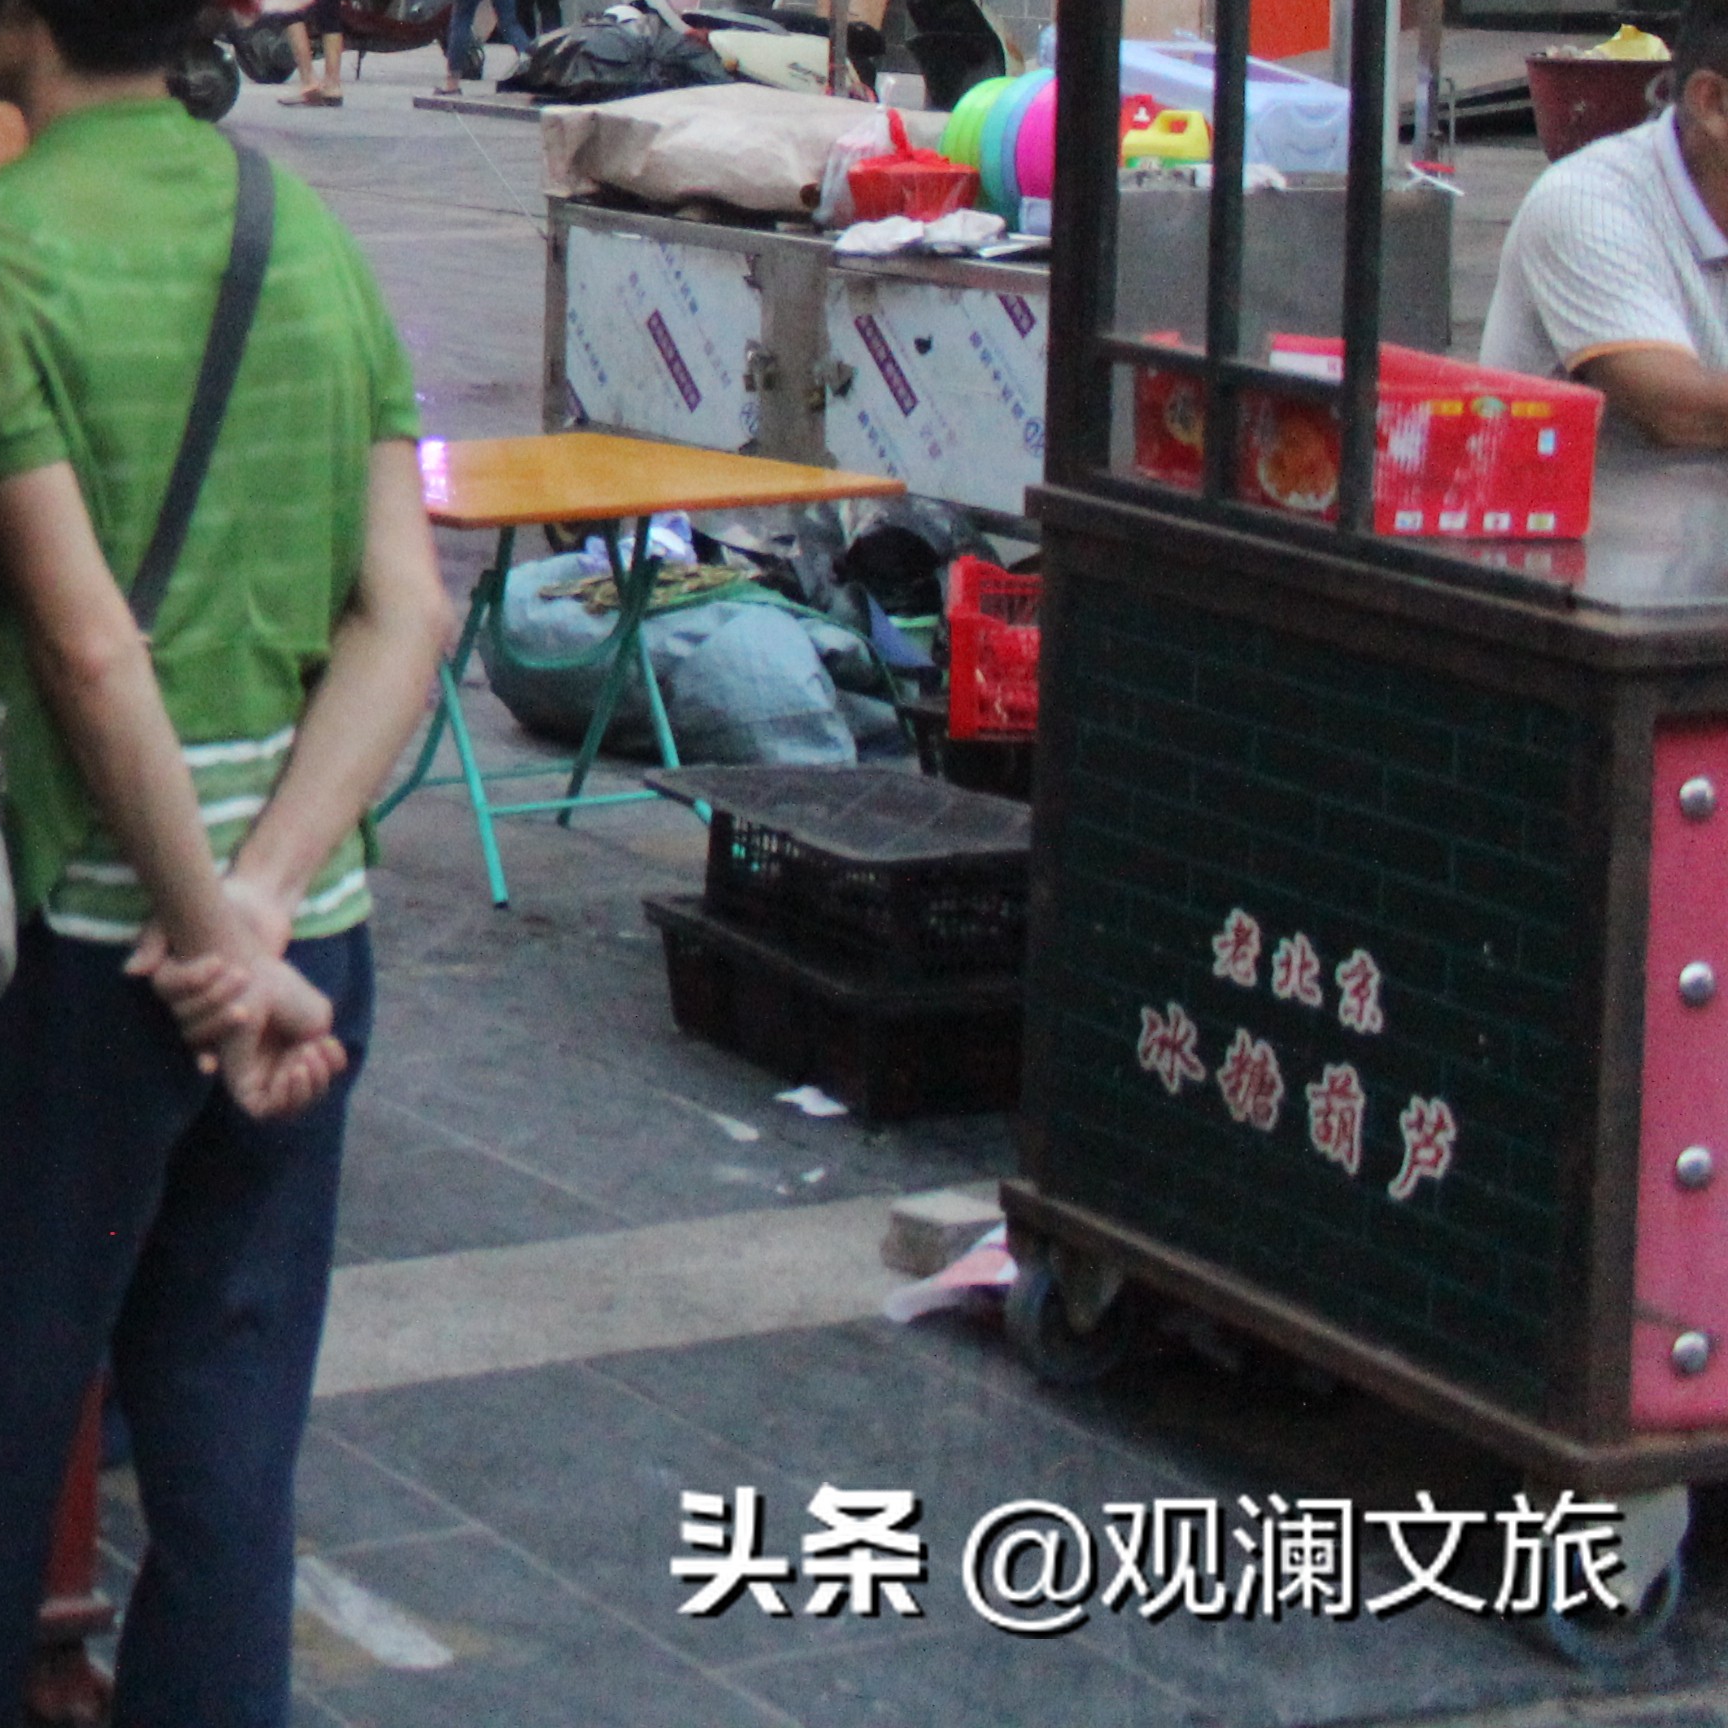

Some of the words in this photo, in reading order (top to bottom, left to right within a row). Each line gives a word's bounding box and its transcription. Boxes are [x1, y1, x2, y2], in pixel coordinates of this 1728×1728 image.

[1212, 907, 1384, 1035] 老北京
[1137, 1001, 1458, 1202] 冰糖葫芦
